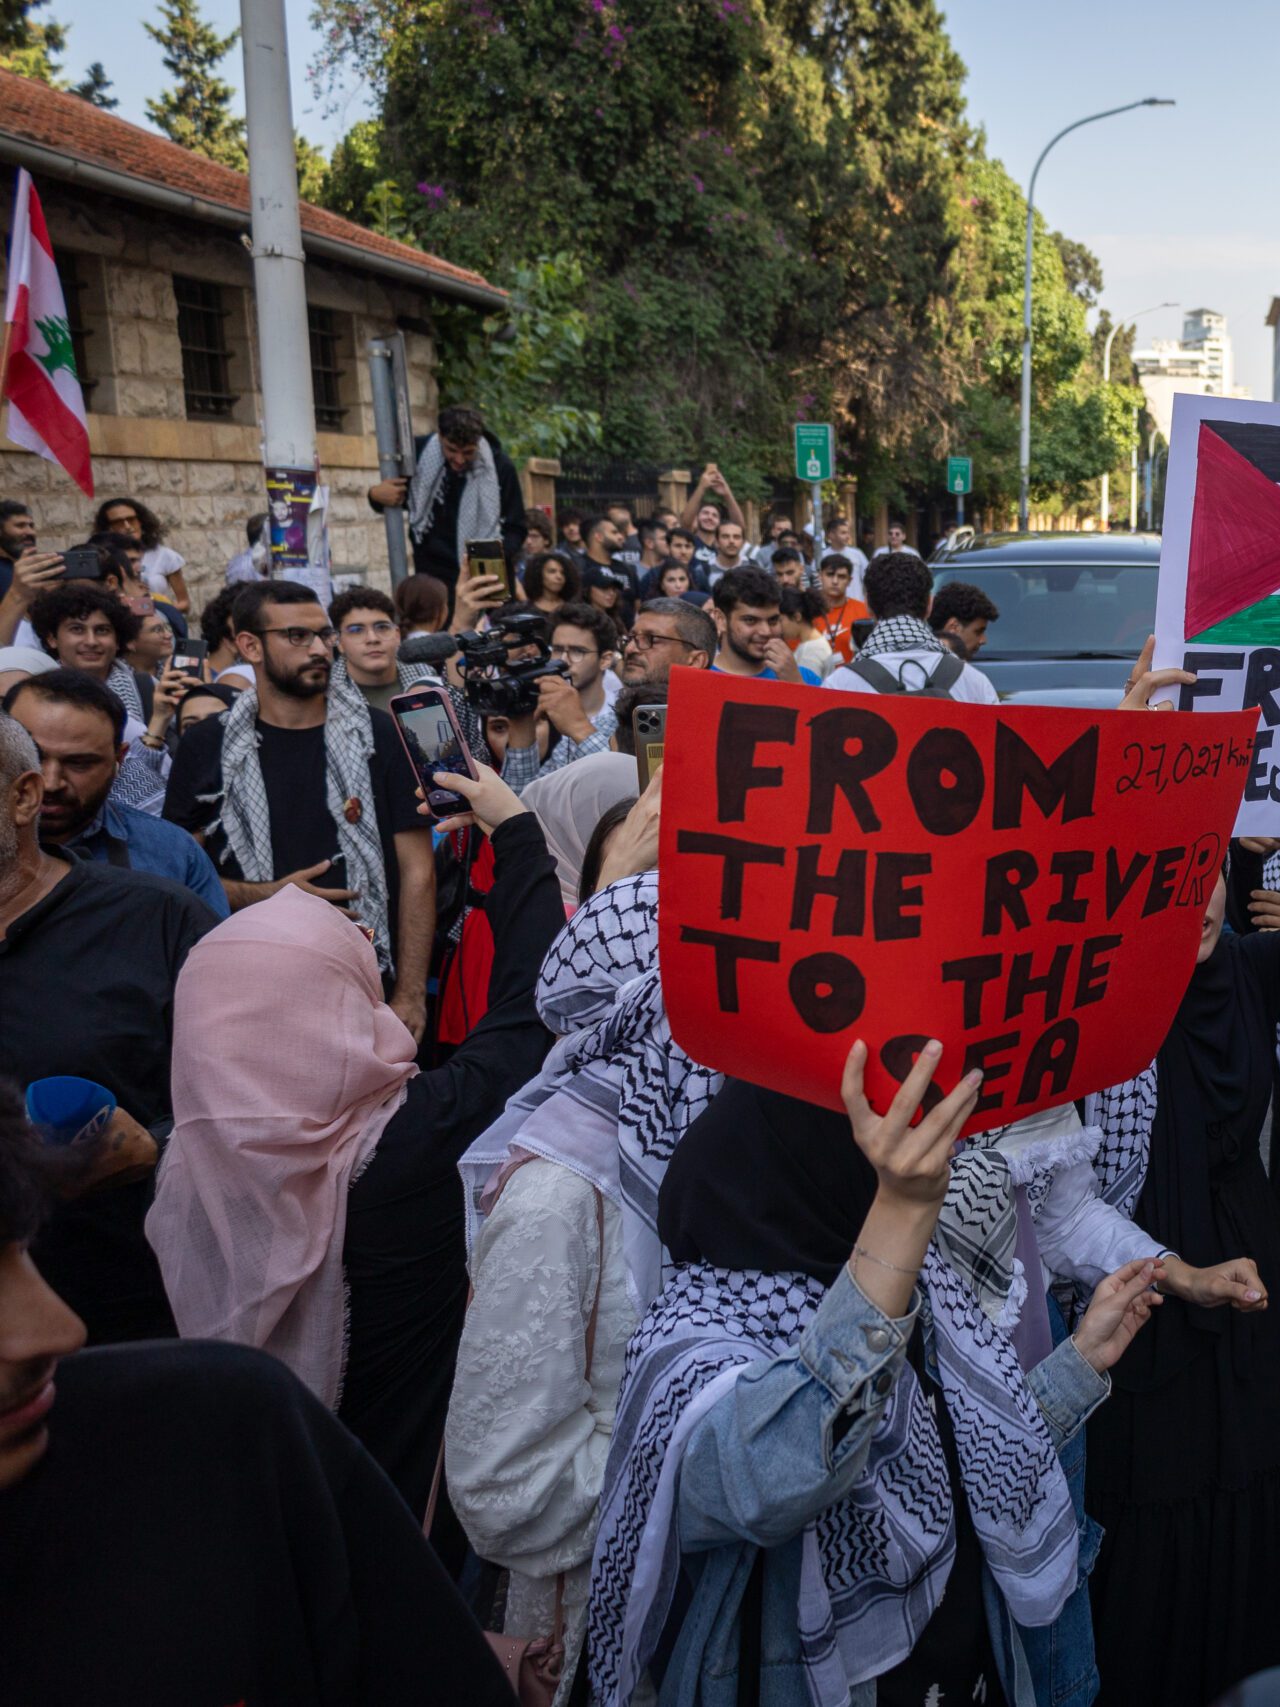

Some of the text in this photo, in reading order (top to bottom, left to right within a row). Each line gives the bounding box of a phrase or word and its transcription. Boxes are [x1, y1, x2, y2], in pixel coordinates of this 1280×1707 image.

[716, 701, 1099, 836] FROM
[1116, 742, 1223, 794] 27,027
[677, 829, 1221, 942] THE RIVER
[680, 925, 1123, 1033] TO THE
